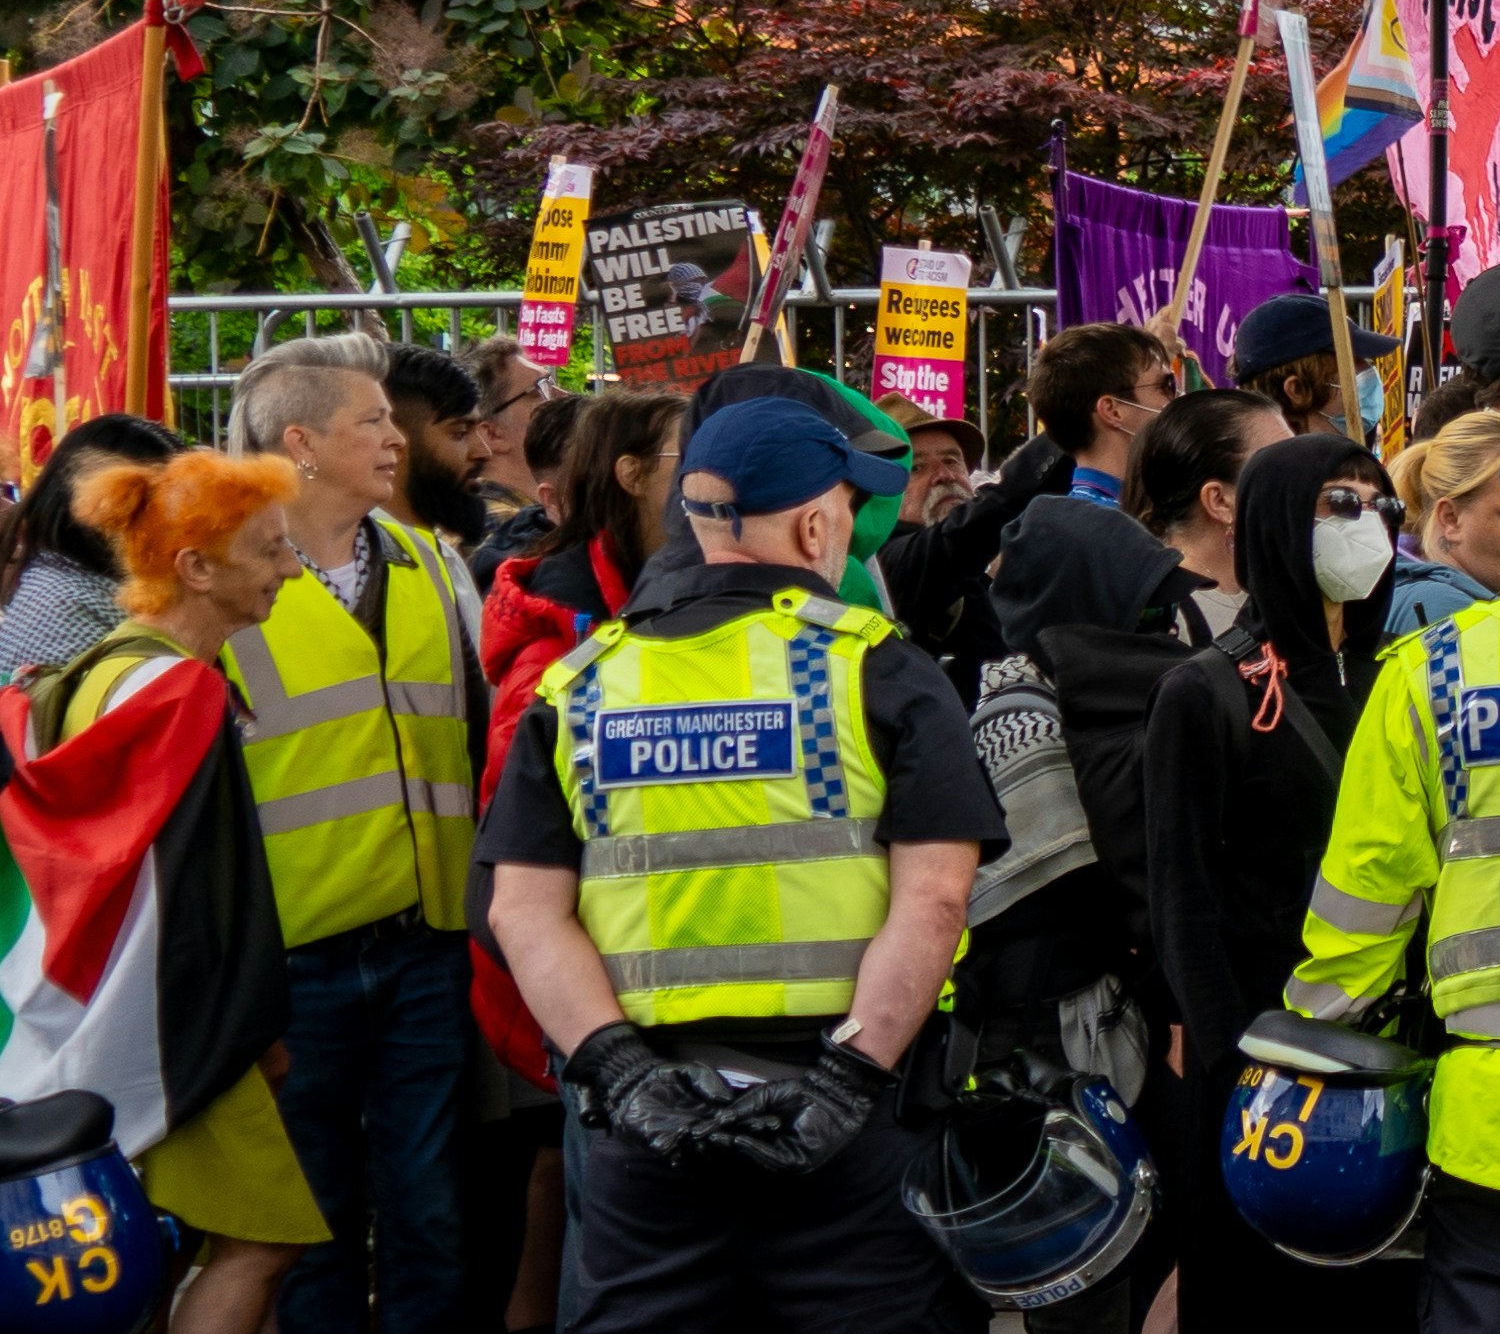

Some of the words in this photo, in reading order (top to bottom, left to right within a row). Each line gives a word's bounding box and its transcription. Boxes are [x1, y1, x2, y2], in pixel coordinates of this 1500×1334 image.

[588, 207, 748, 255] PALESTINE
[592, 247, 674, 283] WILL
[601, 283, 646, 314] BE
[886, 288, 960, 322] Reugees
[608, 307, 688, 343] FREE
[884, 323, 955, 350] wecome
[615, 335, 692, 367] FROM
[674, 349, 743, 377] RIVE
[880, 362, 916, 395] Stp
[917, 365, 949, 392] the
[605, 715, 671, 740] GREATER
[676, 711, 785, 734] MANCHESTER
[630, 734, 759, 775] POLICE
[1297, 1076, 1325, 1123] L
[1232, 1109, 1304, 1169] CK
[10, 1219, 64, 1249] 8176
[60, 1195, 108, 1244] G
[25, 1246, 120, 1306] CK
[1016, 1277, 1082, 1308] POLICE
